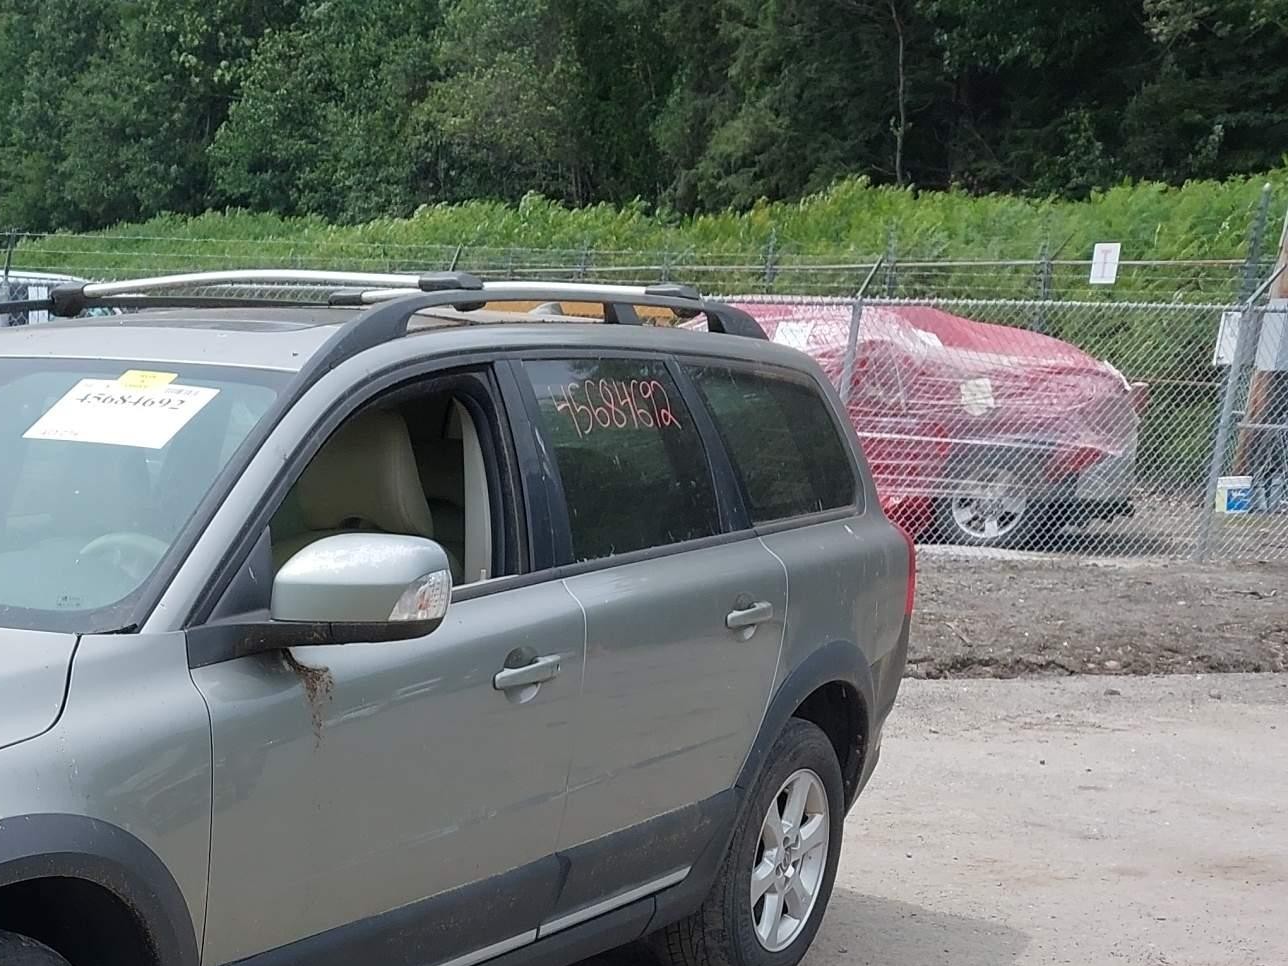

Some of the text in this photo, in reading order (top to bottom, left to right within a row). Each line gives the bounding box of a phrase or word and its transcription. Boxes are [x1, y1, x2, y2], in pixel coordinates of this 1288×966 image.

[1099, 250, 1114, 279] T
[76, 393, 186, 410] 45684692
[547, 378, 682, 439] 45684692
